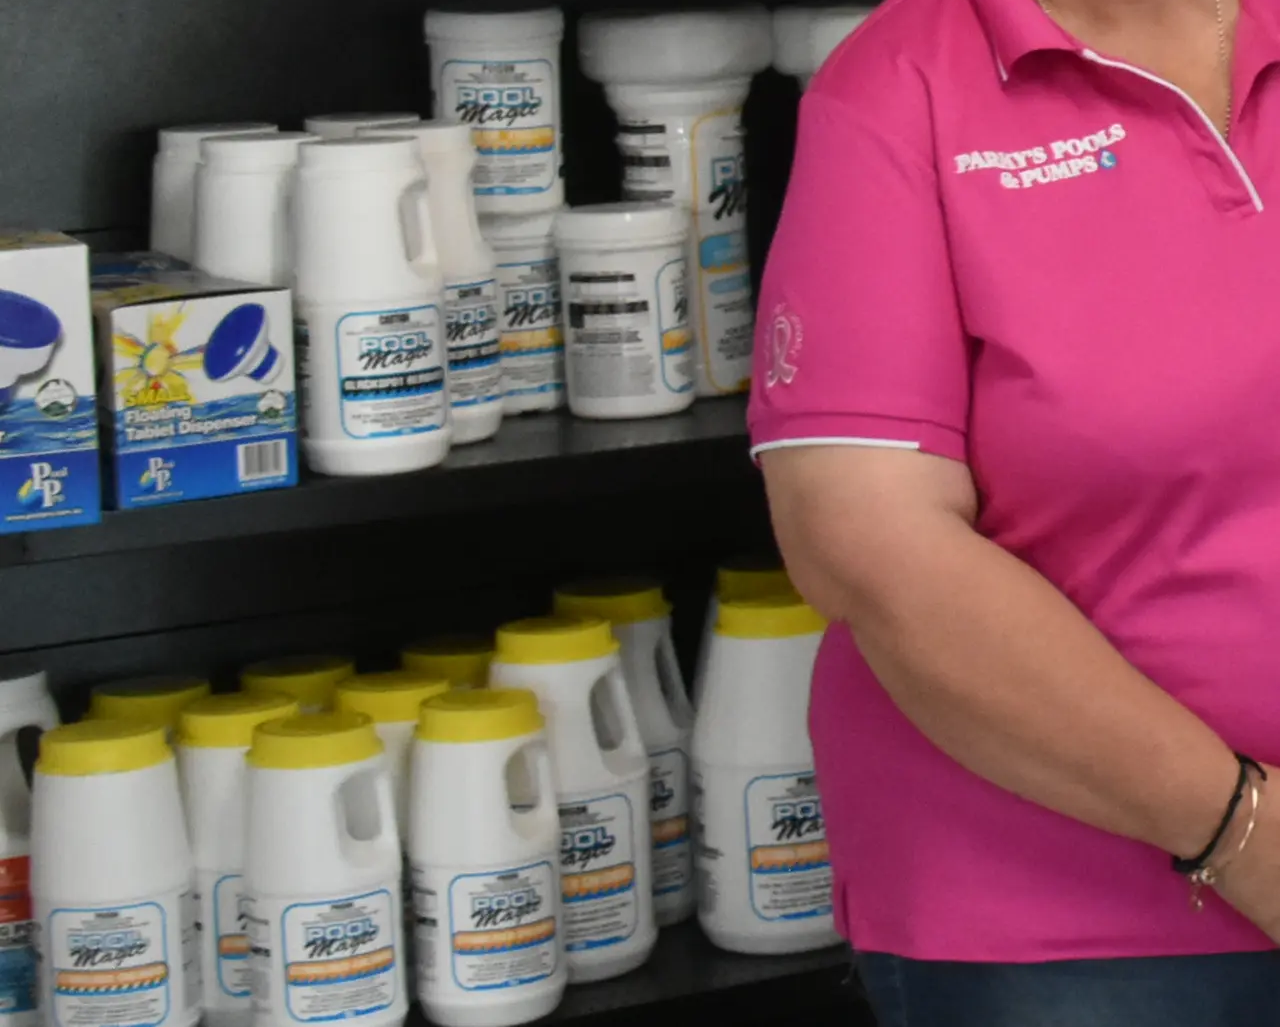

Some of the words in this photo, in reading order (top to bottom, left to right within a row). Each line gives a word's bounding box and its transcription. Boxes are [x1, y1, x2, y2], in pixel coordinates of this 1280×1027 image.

[457, 86, 543, 108] POOL
[455, 104, 539, 128] Magic
[954, 145, 1049, 174] PARKY'S
[1050, 123, 1127, 160] POOLS
[1000, 171, 1020, 189] &
[1020, 155, 1099, 189] PUMPS
[359, 331, 433, 355] POOL
[358, 346, 433, 371] Magic
[125, 405, 192, 423] Floating
[125, 424, 175, 441] Tablet
[178, 415, 258, 435] Dispenser
[472, 889, 544, 914] POOL
[304, 930, 380, 959] Magic
[305, 919, 381, 945] POOL
